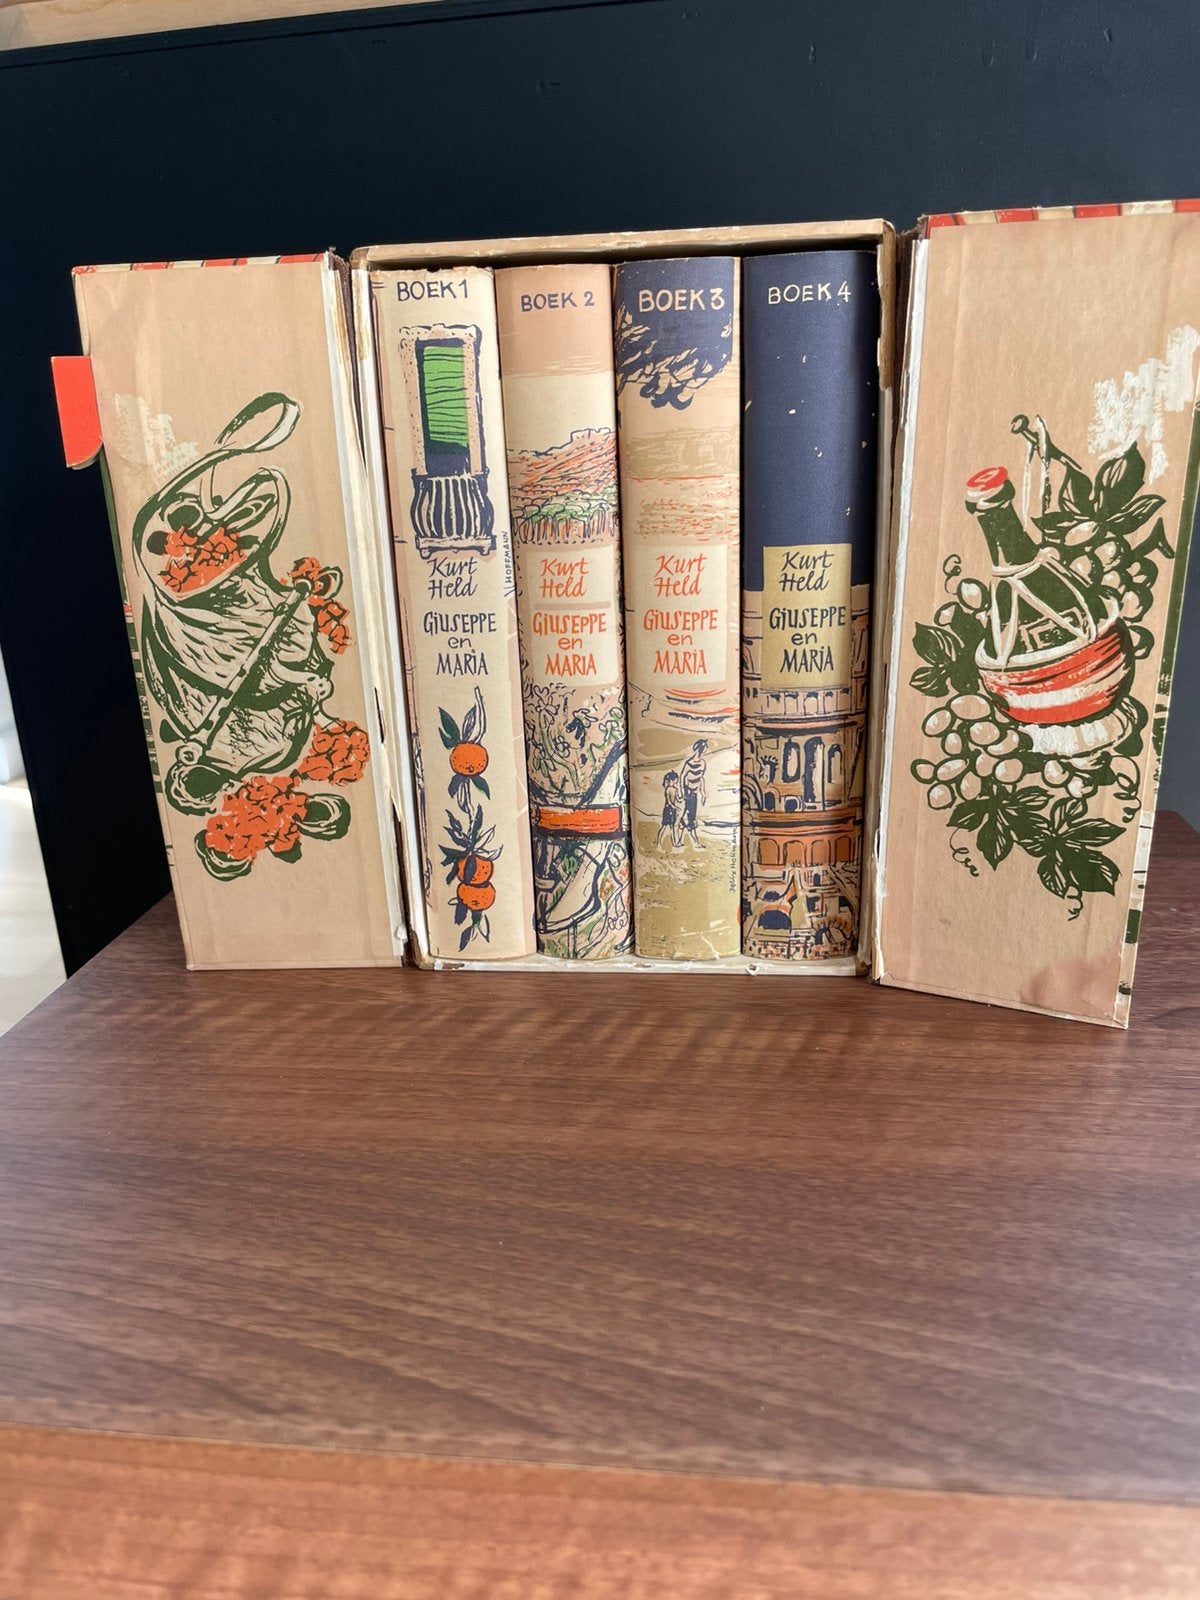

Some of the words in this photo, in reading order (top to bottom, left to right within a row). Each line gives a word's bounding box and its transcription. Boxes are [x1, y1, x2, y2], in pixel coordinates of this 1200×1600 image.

[397, 281, 456, 301] BOEK
[458, 279, 468, 298] 1
[639, 289, 706, 312] BOEK
[710, 288, 725, 310] 3
[768, 283, 832, 304] BOEK
[838, 281, 851, 302] 4
[521, 292, 577, 312] BOEK
[584, 291, 595, 307] 2
[428, 557, 478, 577] Kurt
[501, 531, 513, 583] HOFFMANN
[540, 558, 589, 577] Kurt
[655, 553, 707, 577] Kurt
[781, 550, 834, 572] Kurt
[428, 576, 478, 598] Held
[540, 576, 588, 598] Held
[654, 573, 702, 597] Held
[779, 569, 829, 592] Held
[448, 636, 472, 649] en
[558, 637, 583, 650] en
[667, 633, 693, 646] en
[791, 632, 817, 645] en
